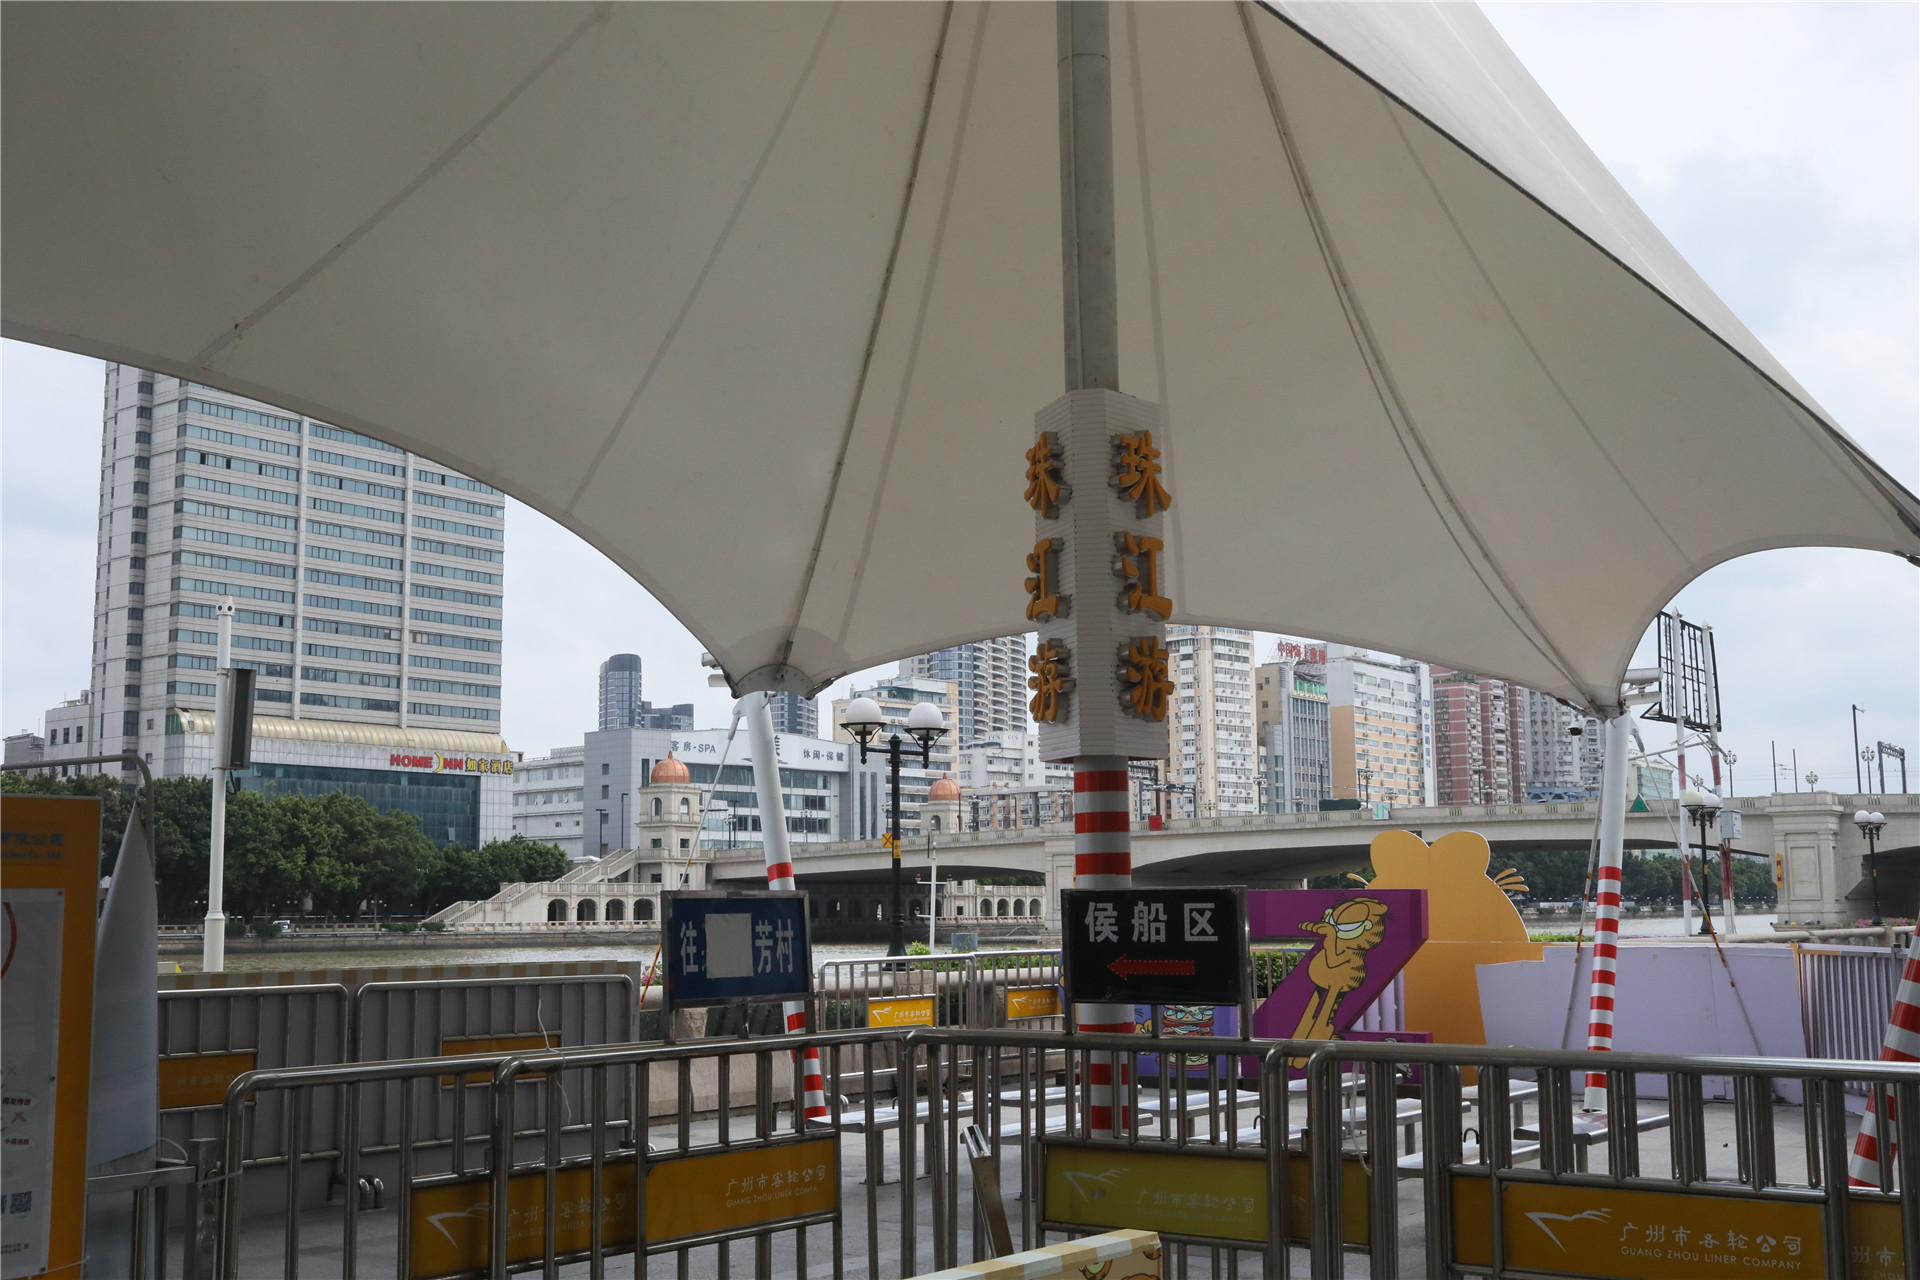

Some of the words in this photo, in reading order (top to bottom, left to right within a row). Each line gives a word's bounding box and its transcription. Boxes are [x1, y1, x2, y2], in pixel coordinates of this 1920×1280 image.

[1119, 430, 1174, 723] 珠江游
[390, 754, 433, 768] HOME
[465, 758, 513, 774] 如家酒店
[755, 919, 794, 973] 芳村
[726, 1164, 826, 1197] 广州市客轮公司
[726, 1196, 751, 1208] GUANG
[753, 1193, 772, 1204] ZHOU
[1621, 1246, 1662, 1258] GUANG
[1668, 1250, 1699, 1262] ZHOU
[1705, 1253, 1737, 1265] LINER
[1743, 1257, 1802, 1270] COMPANY
